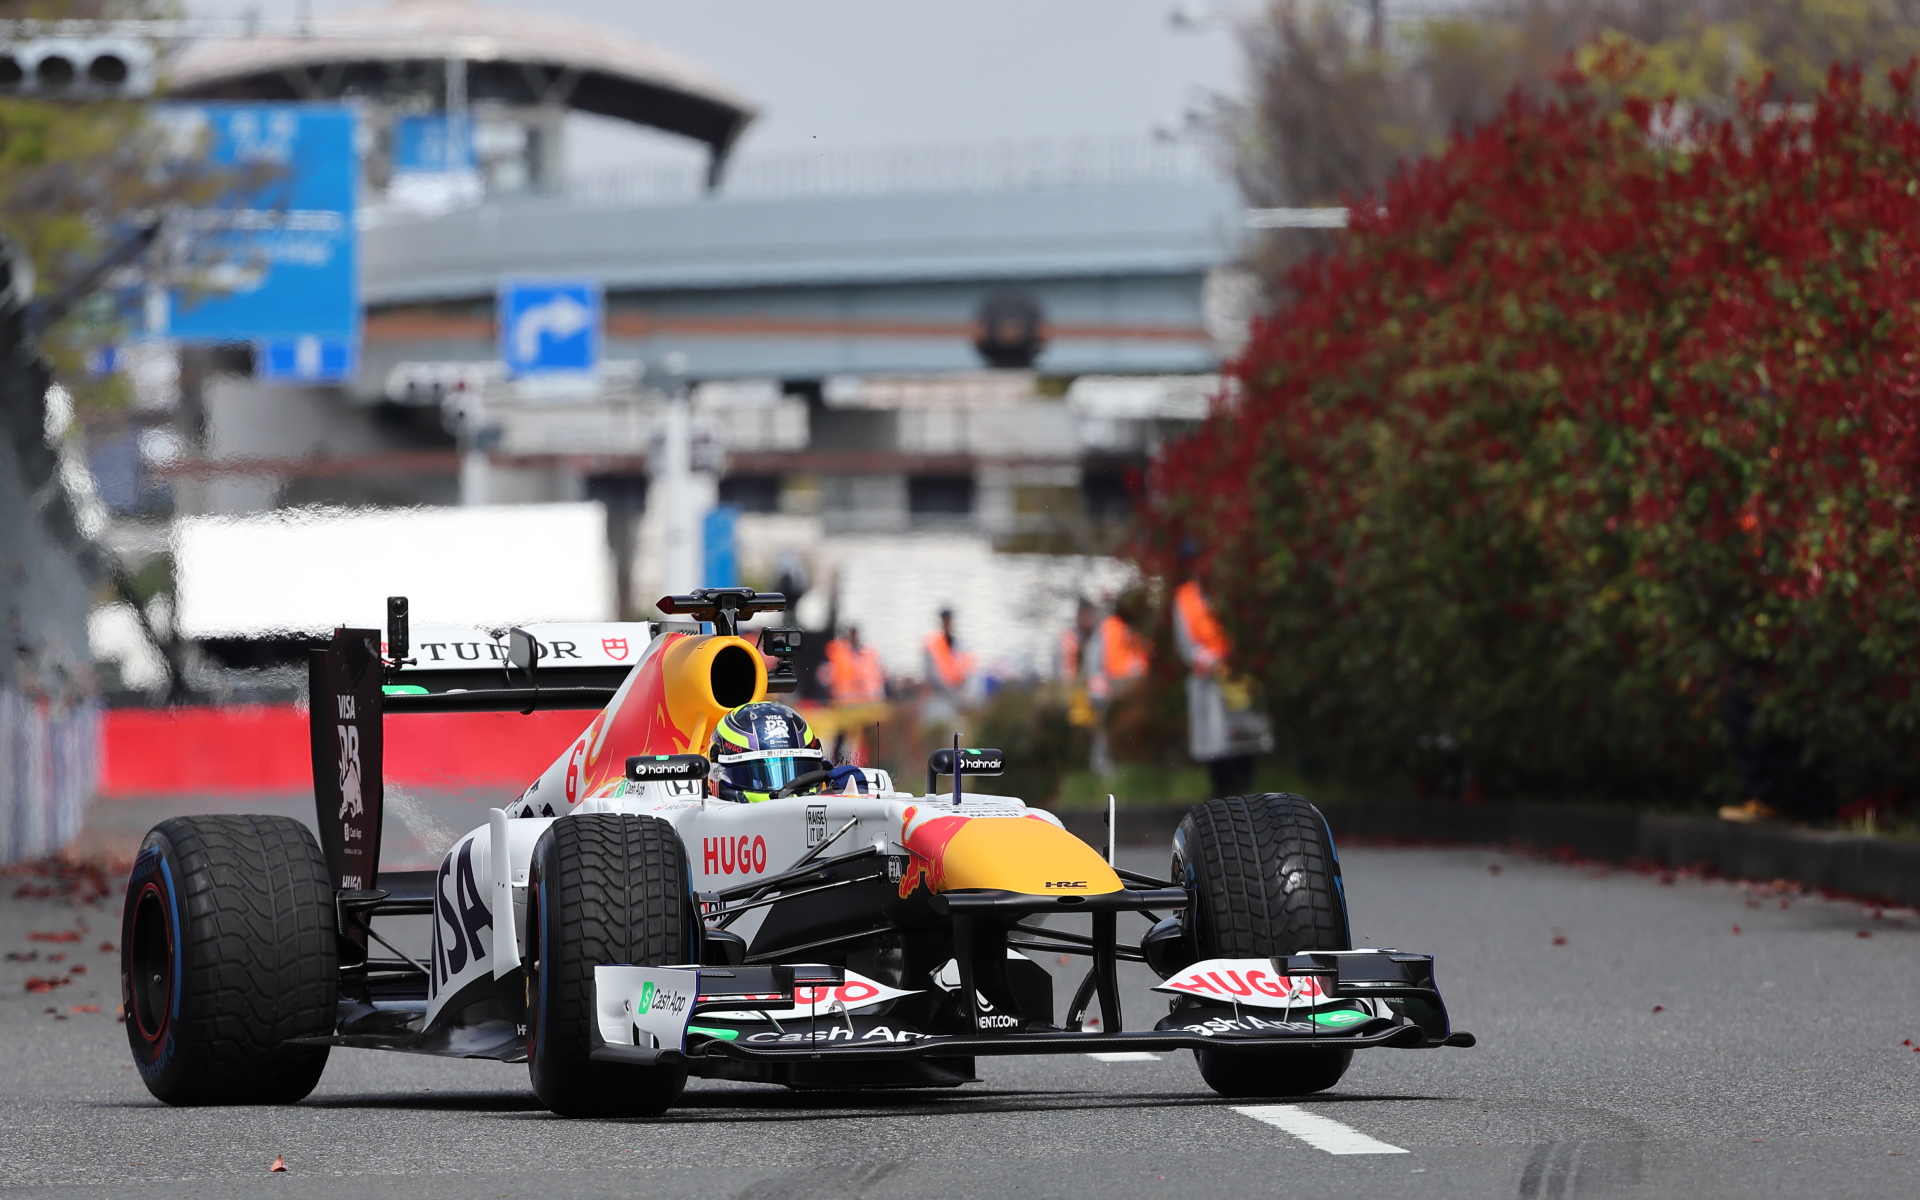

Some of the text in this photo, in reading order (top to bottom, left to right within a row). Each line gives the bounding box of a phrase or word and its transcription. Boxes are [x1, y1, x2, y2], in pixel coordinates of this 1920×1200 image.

[337, 694, 356, 720] VISA
[723, 741, 743, 754] HUGO
[565, 739, 586, 803] 6
[648, 763, 690, 775] hahnair
[966, 758, 1002, 769] hahnair
[624, 781, 645, 798] Cash App
[807, 811, 825, 826] RAISE
[809, 827, 824, 843] IT UP
[703, 834, 767, 875] HUGO
[651, 988, 671, 1012] Cash
[670, 990, 686, 1016] App
[746, 1025, 854, 1043] Cash
